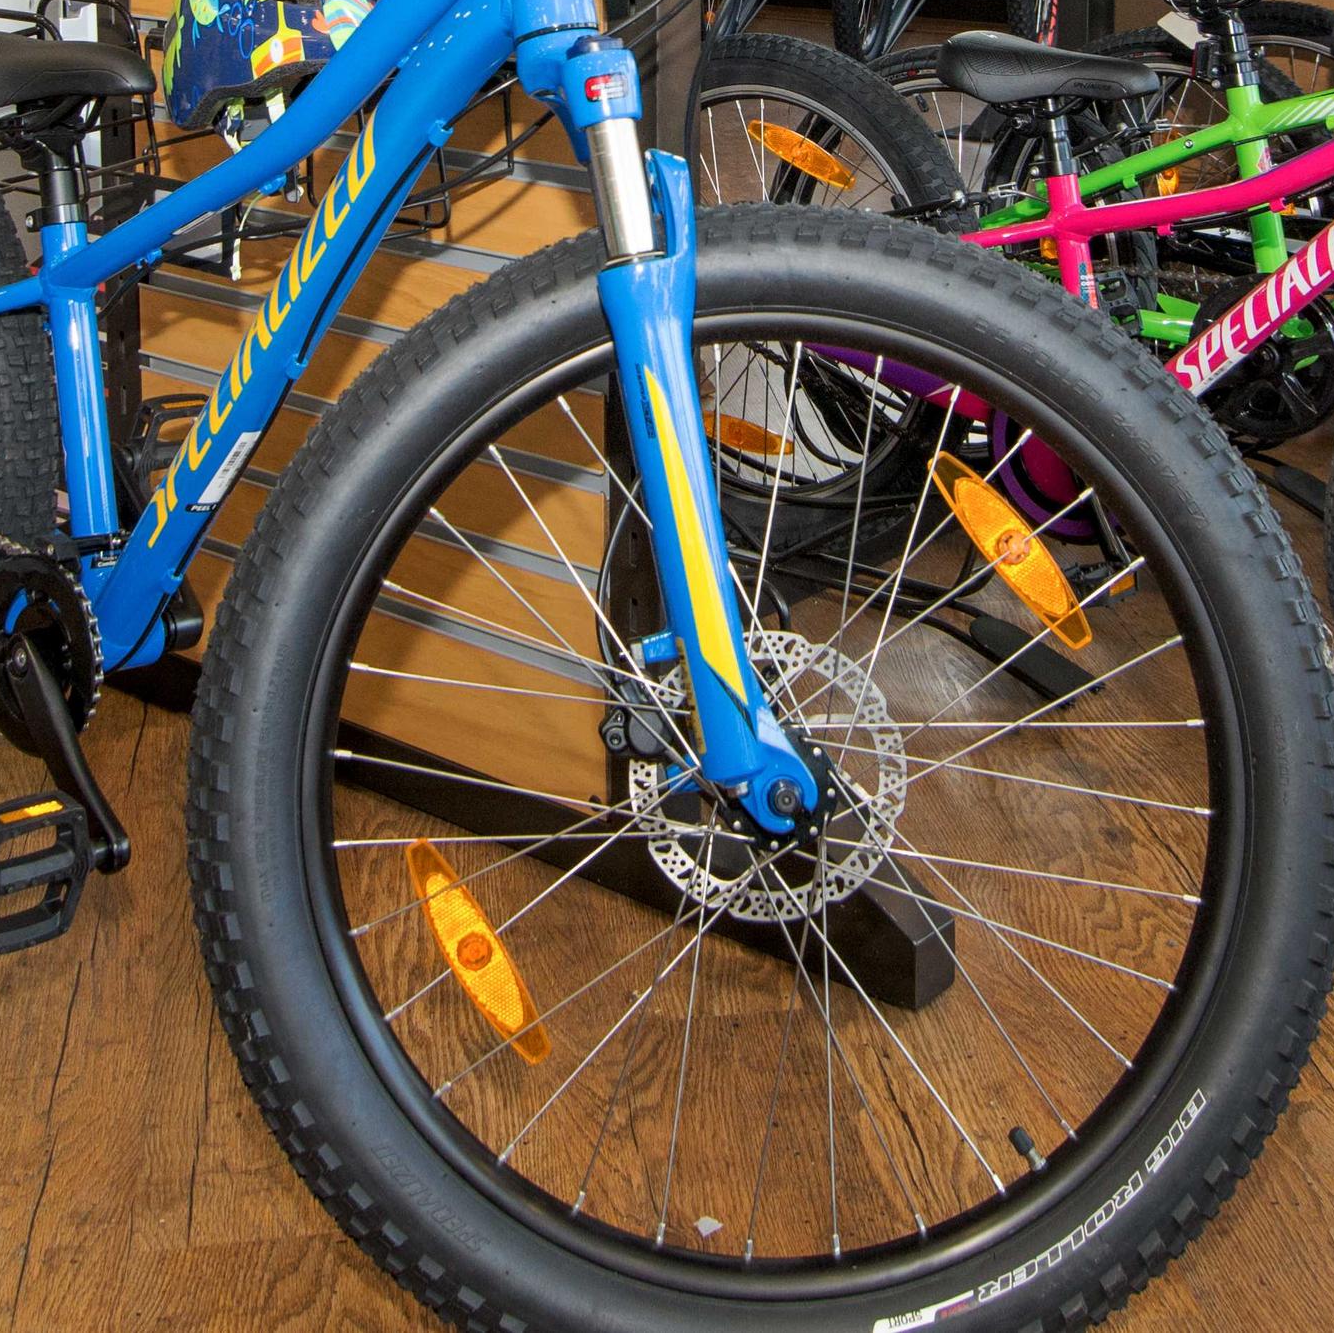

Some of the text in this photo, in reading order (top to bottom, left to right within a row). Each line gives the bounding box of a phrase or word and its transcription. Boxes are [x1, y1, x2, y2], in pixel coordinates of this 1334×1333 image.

[148, 110, 378, 549] SPECIALIZED
[190, 504, 211, 513] PEEL
[977, 1087, 1208, 1303] BIG ROLLER
